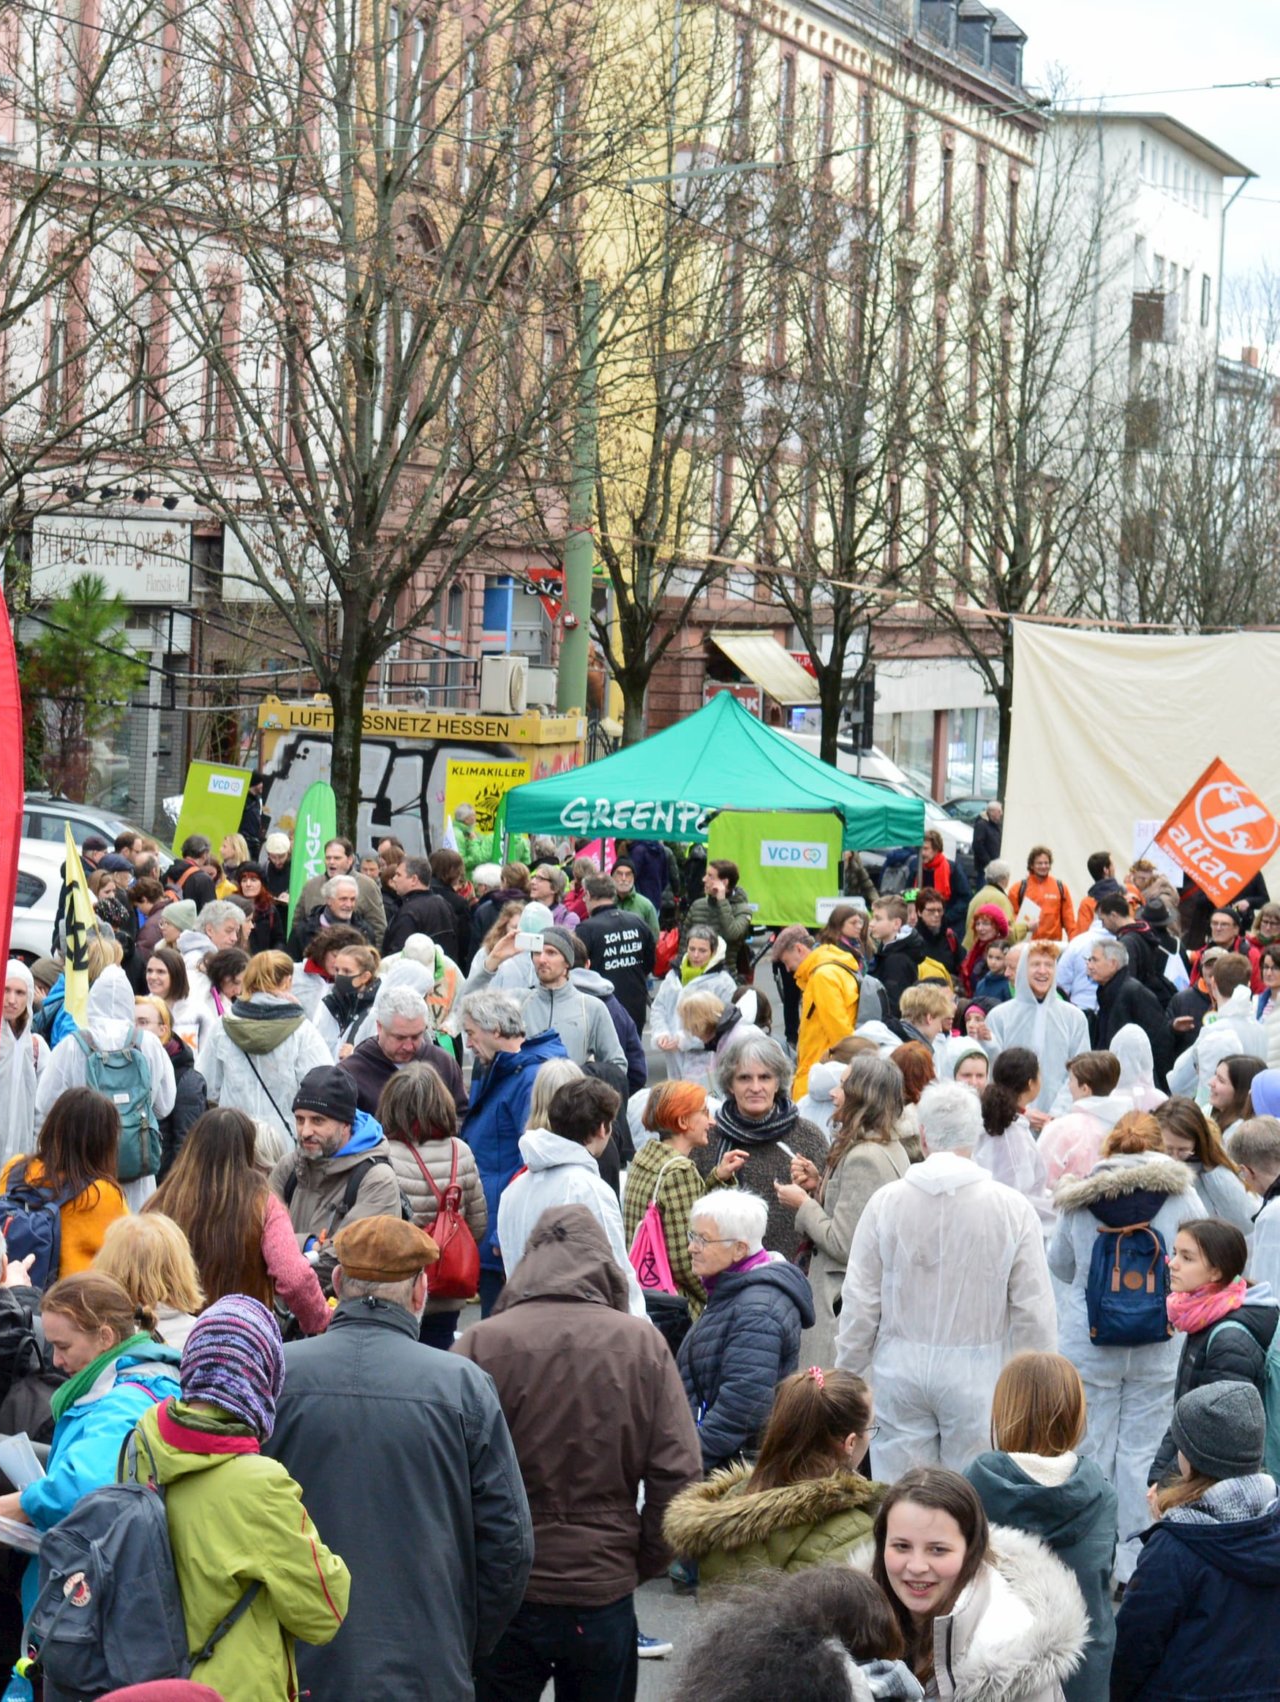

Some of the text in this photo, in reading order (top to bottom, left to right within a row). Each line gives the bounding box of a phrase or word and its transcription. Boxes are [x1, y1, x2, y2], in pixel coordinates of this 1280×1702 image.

[115, 529, 187, 568] FLOWERS
[289, 711, 509, 737] LUFTSSNETZ HESSEN
[451, 766, 526, 778] KLIMAKILLER
[212, 779, 230, 790] VCD
[768, 846, 801, 863] VCD
[1168, 823, 1243, 890] attac
[604, 928, 639, 945] ICH BIN
[603, 941, 643, 958] AN ALLEM
